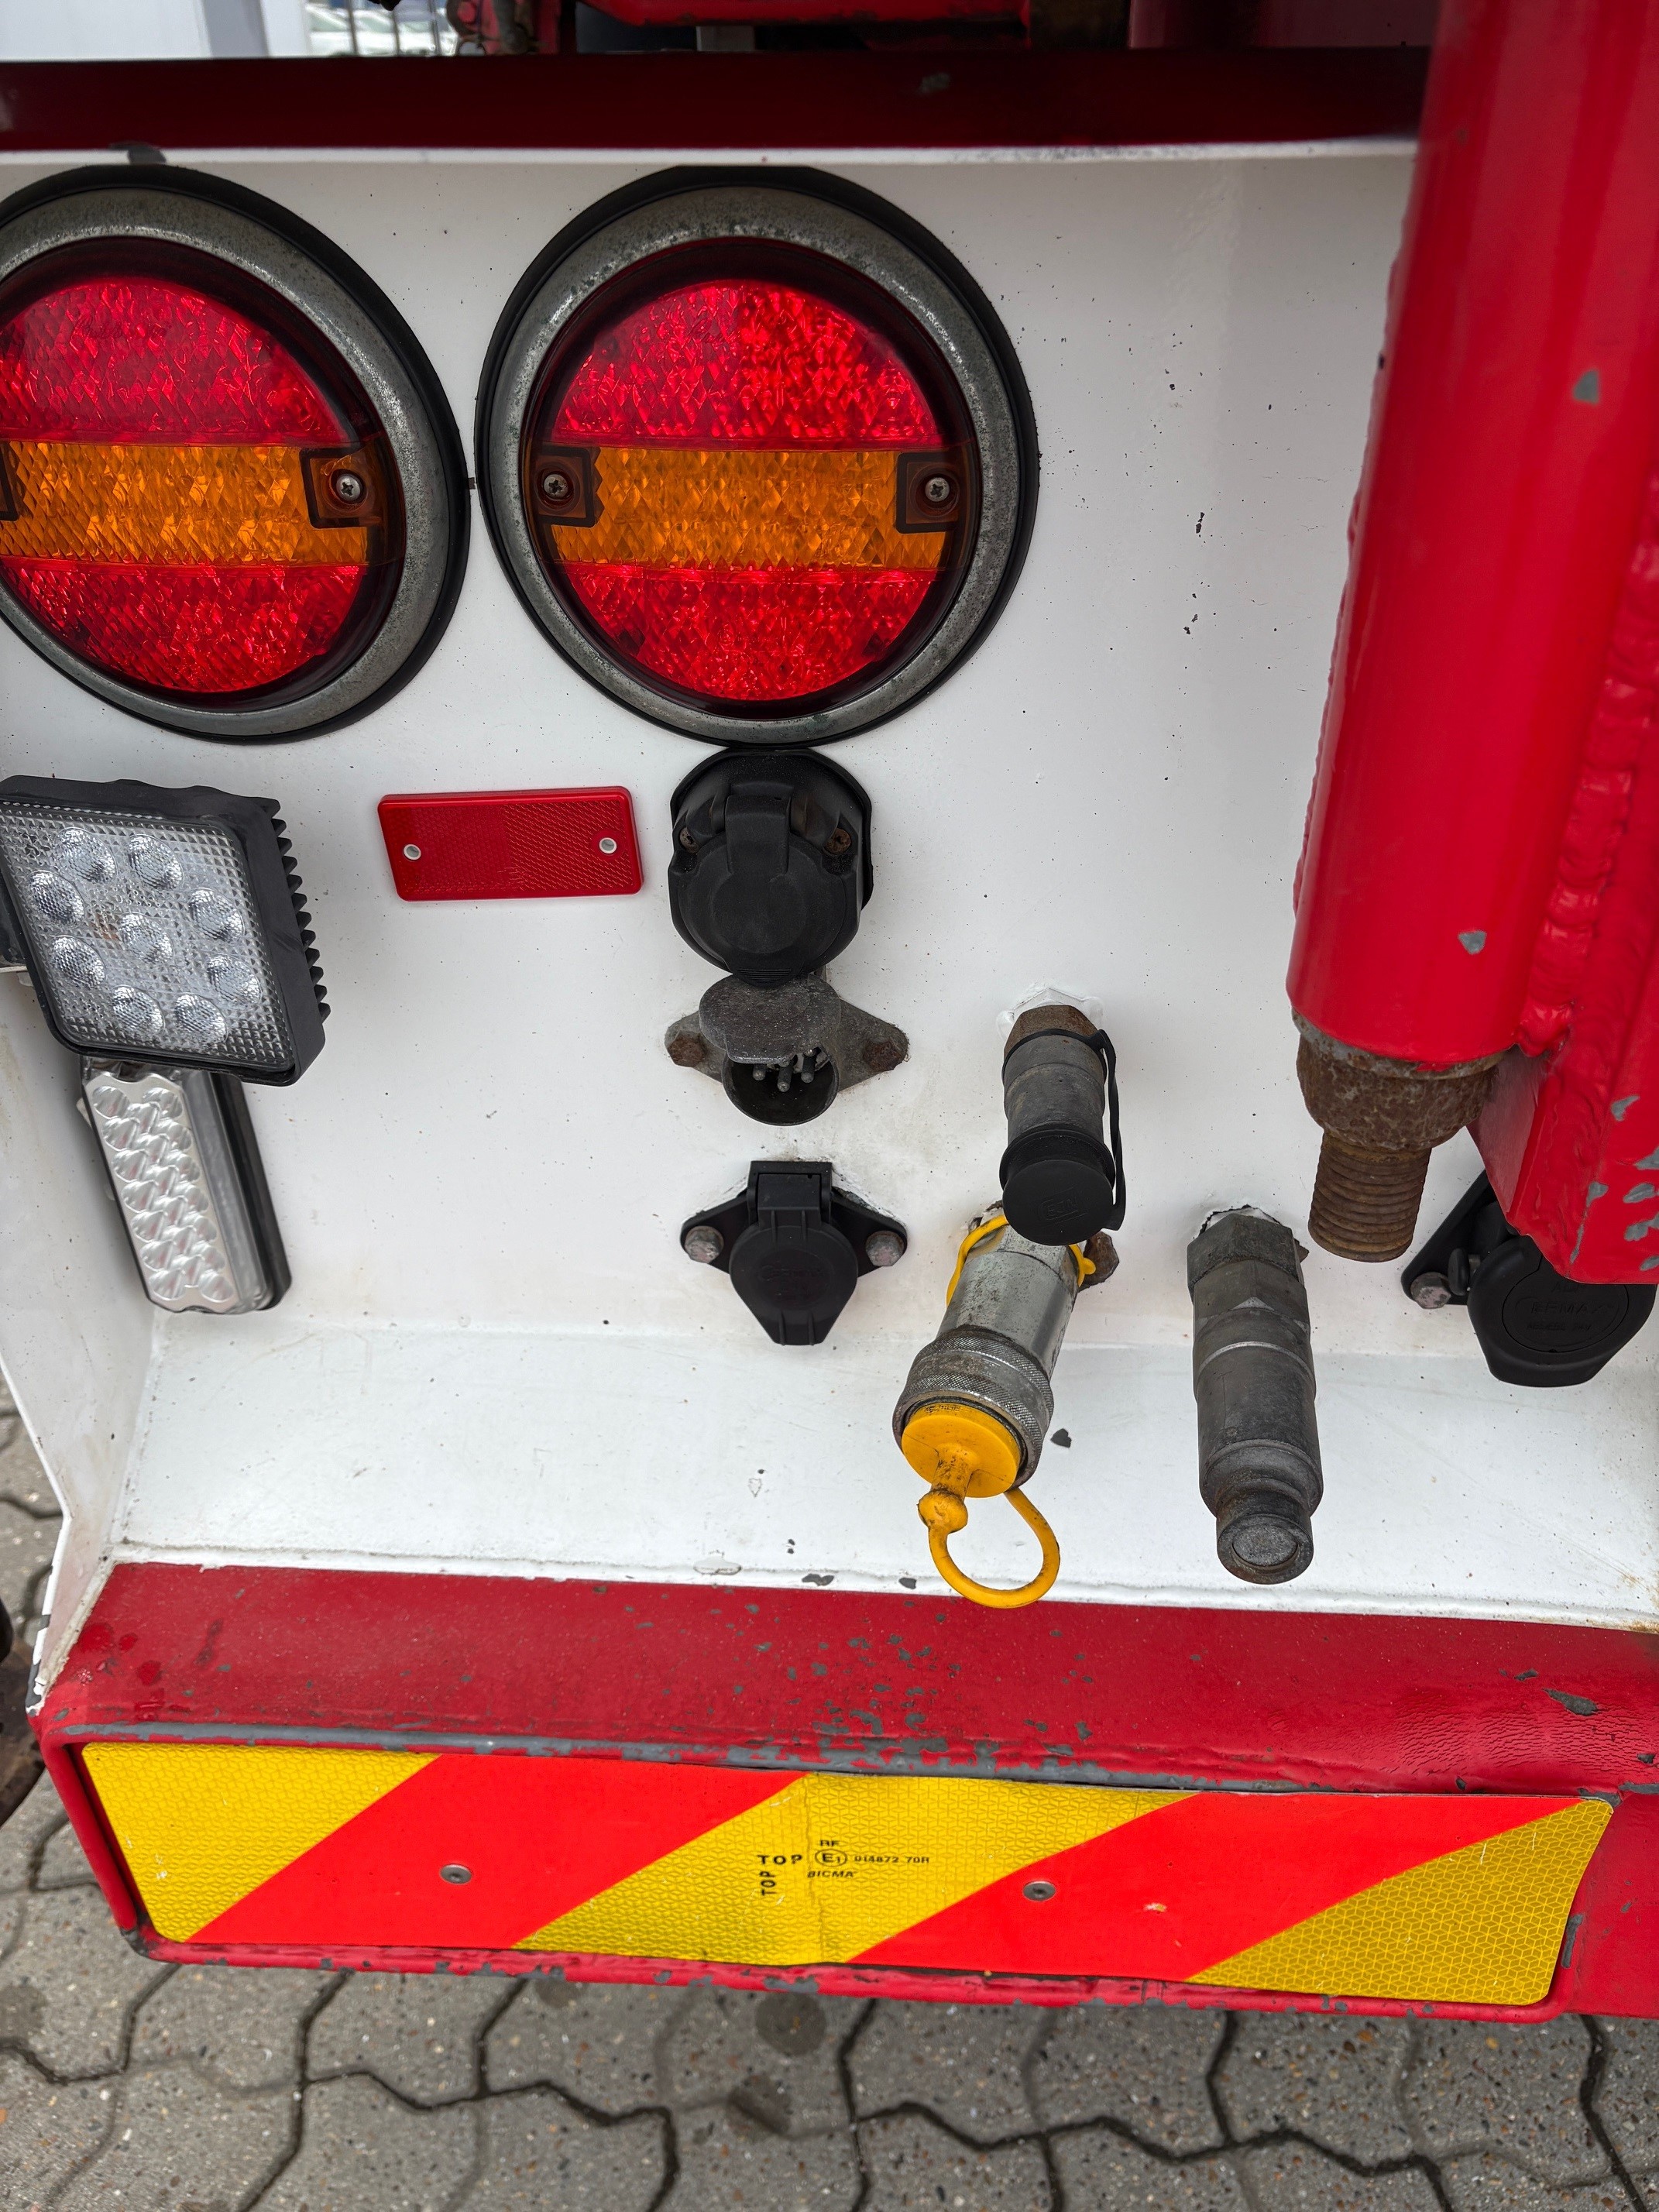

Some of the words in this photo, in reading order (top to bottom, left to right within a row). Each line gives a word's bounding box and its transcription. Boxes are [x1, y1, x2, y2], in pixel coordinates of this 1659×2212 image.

[757, 1854, 803, 1866] TOP
[854, 1855, 900, 1863] 014872
[759, 1870, 777, 1896] TOP
